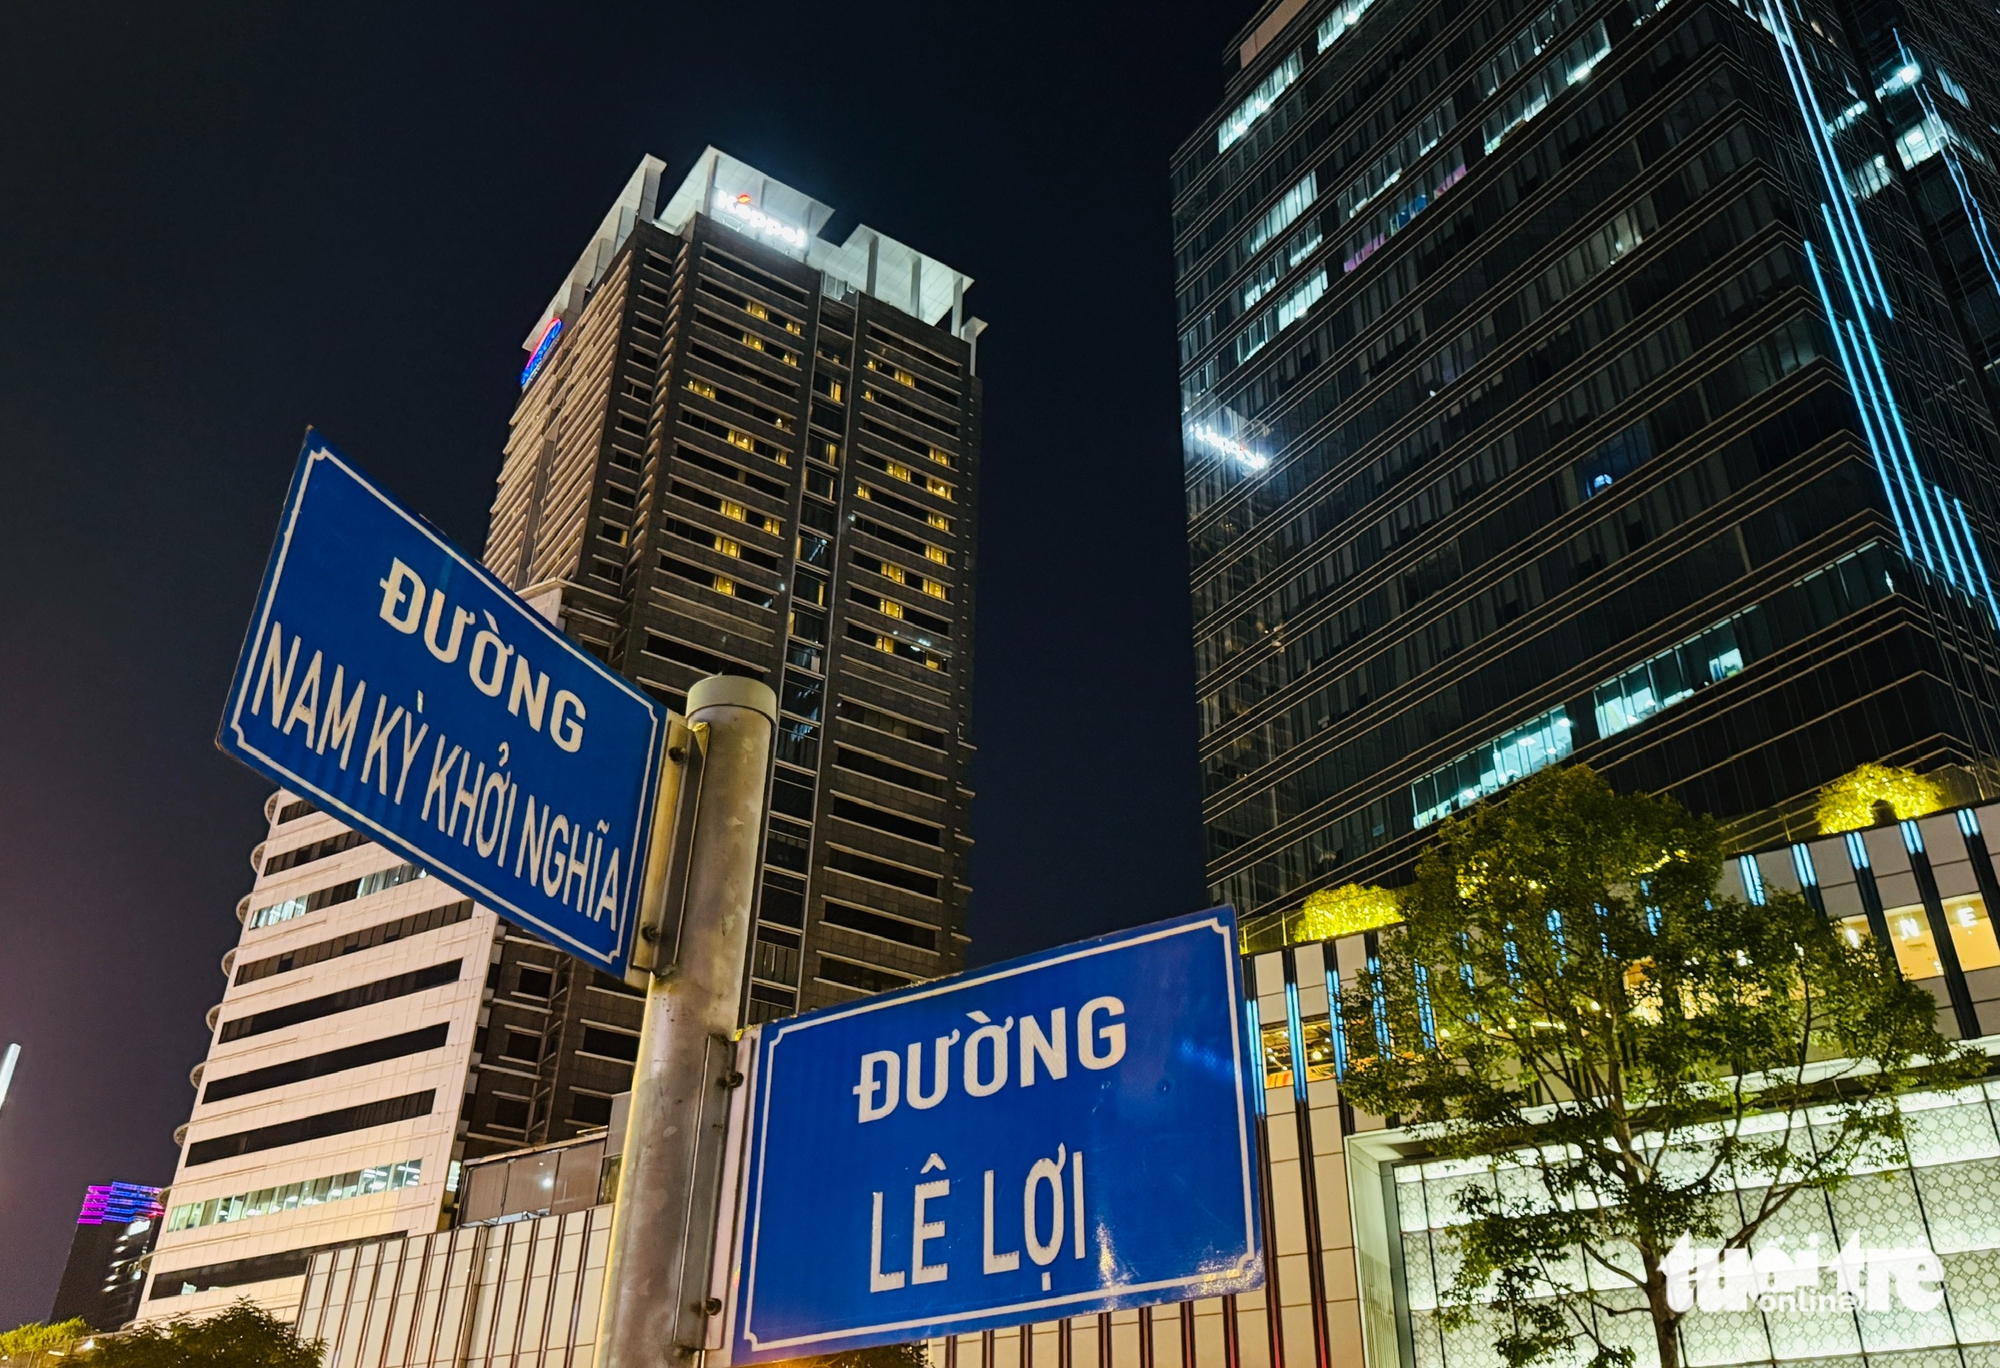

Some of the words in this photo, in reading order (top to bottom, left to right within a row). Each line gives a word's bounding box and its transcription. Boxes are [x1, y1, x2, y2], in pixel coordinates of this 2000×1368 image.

[380, 557, 586, 753] ĐƯỜNG
[251, 621, 366, 771] NAM
[361, 690, 428, 805] KỲ
[421, 741, 518, 868] KHỞI
[514, 794, 620, 931] NGHĨA
[853, 996, 1127, 1123] ĐƯỜNG
[869, 1152, 950, 1293] LÊ
[983, 1142, 1086, 1292] LỢI
